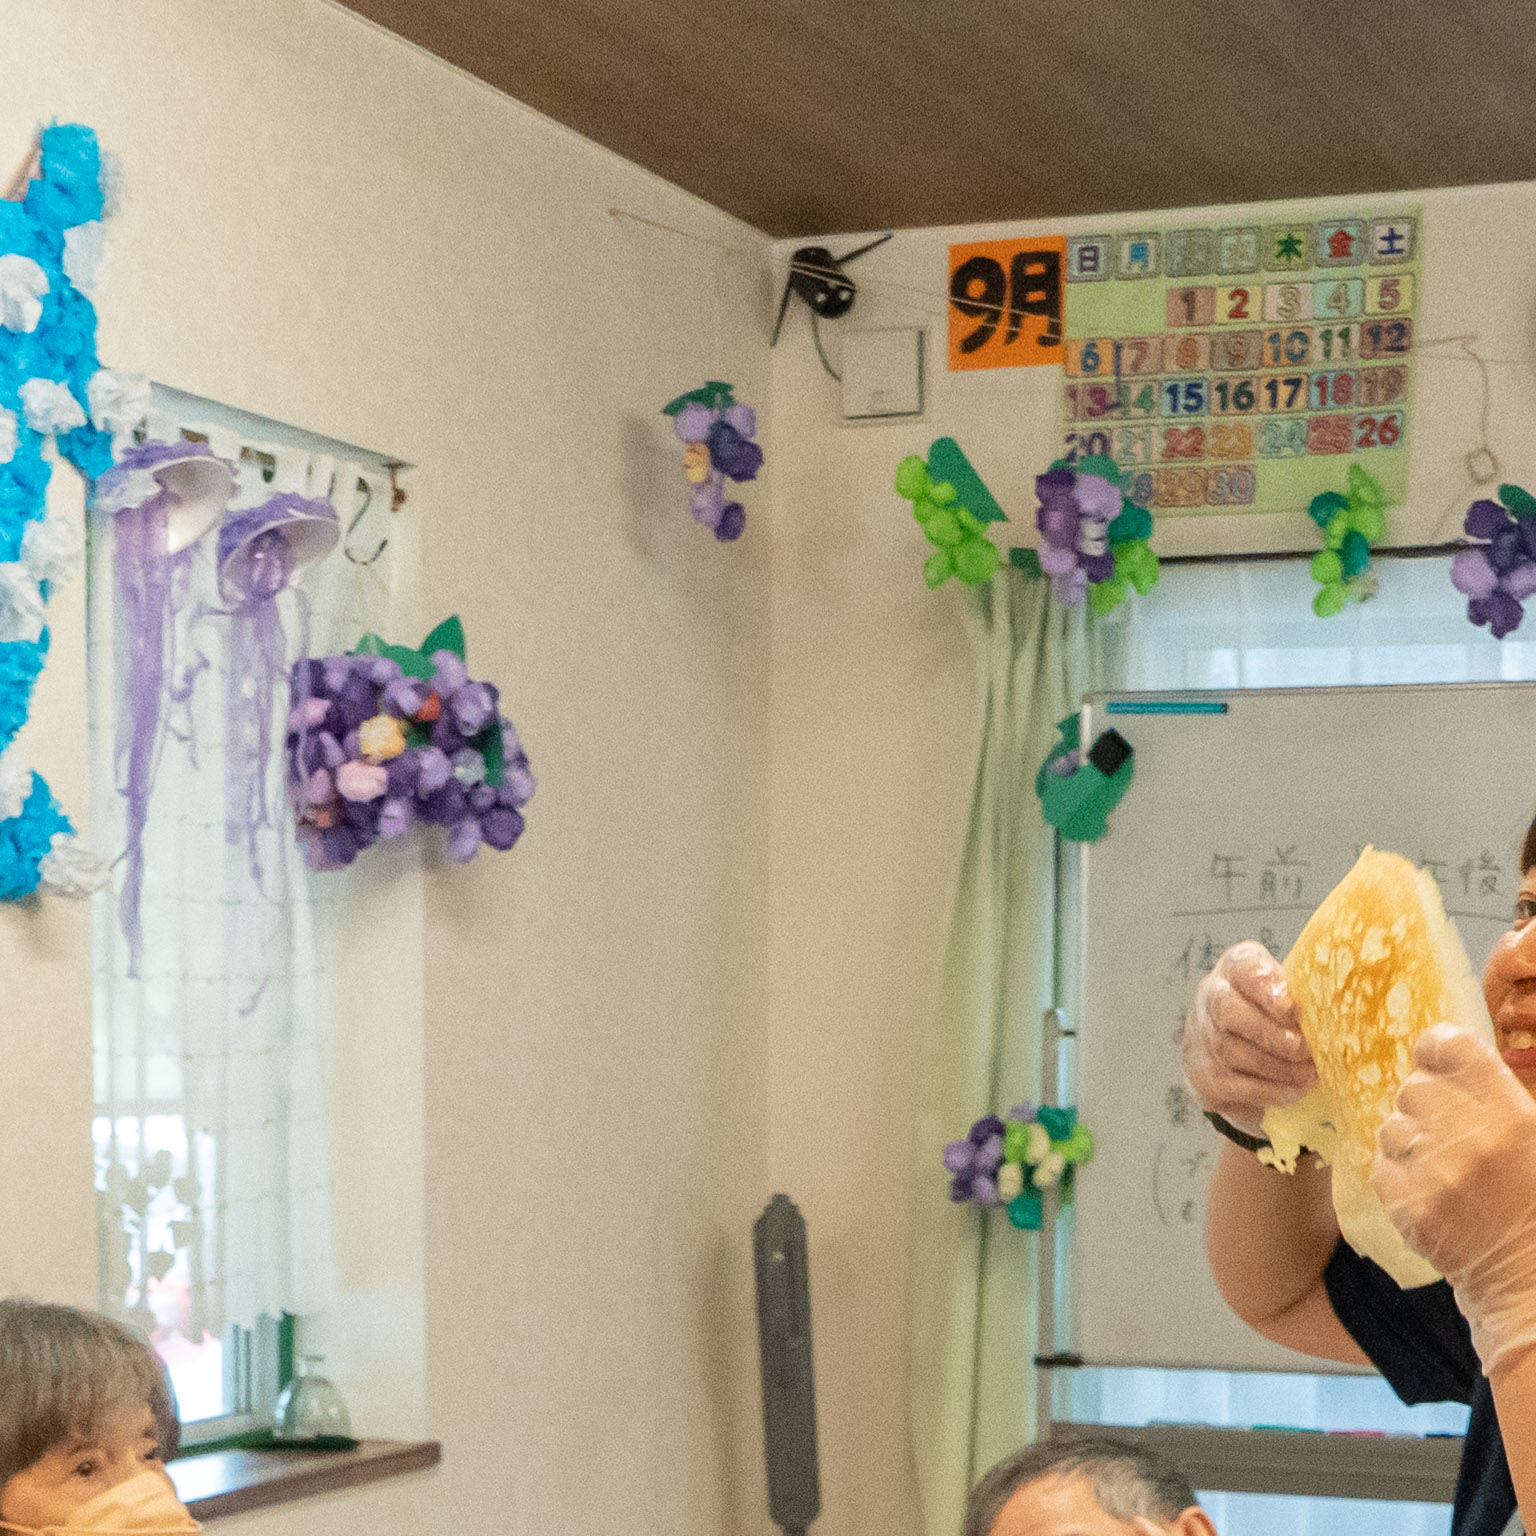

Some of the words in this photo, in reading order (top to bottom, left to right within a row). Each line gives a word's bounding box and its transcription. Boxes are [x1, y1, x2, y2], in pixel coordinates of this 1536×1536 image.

[1079, 246, 1101, 272] 日
[1378, 227, 1404, 255] 土
[950, 251, 1062, 353] 9月
[1181, 290, 1195, 321] 1
[1228, 289, 1249, 318] 2
[1277, 286, 1300, 319] 3
[1326, 283, 1351, 315] 4
[1379, 279, 1400, 310] 5
[1081, 342, 1100, 372] 6
[1127, 341, 1150, 372] 7
[1176, 338, 1197, 369] 8
[1268, 331, 1309, 362] 10
[1320, 327, 1350, 360] 11
[1368, 322, 1407, 352] 12
[1066, 385, 1108, 417] 13
[1166, 382, 1204, 413] 15
[1215, 381, 1254, 411] 16
[1265, 377, 1303, 408] 17
[1315, 374, 1352, 405] 18
[1162, 427, 1206, 457] 22
[1357, 415, 1400, 448] 26
[1210, 468, 1254, 500] 30
[1210, 845, 1312, 901] 午前
